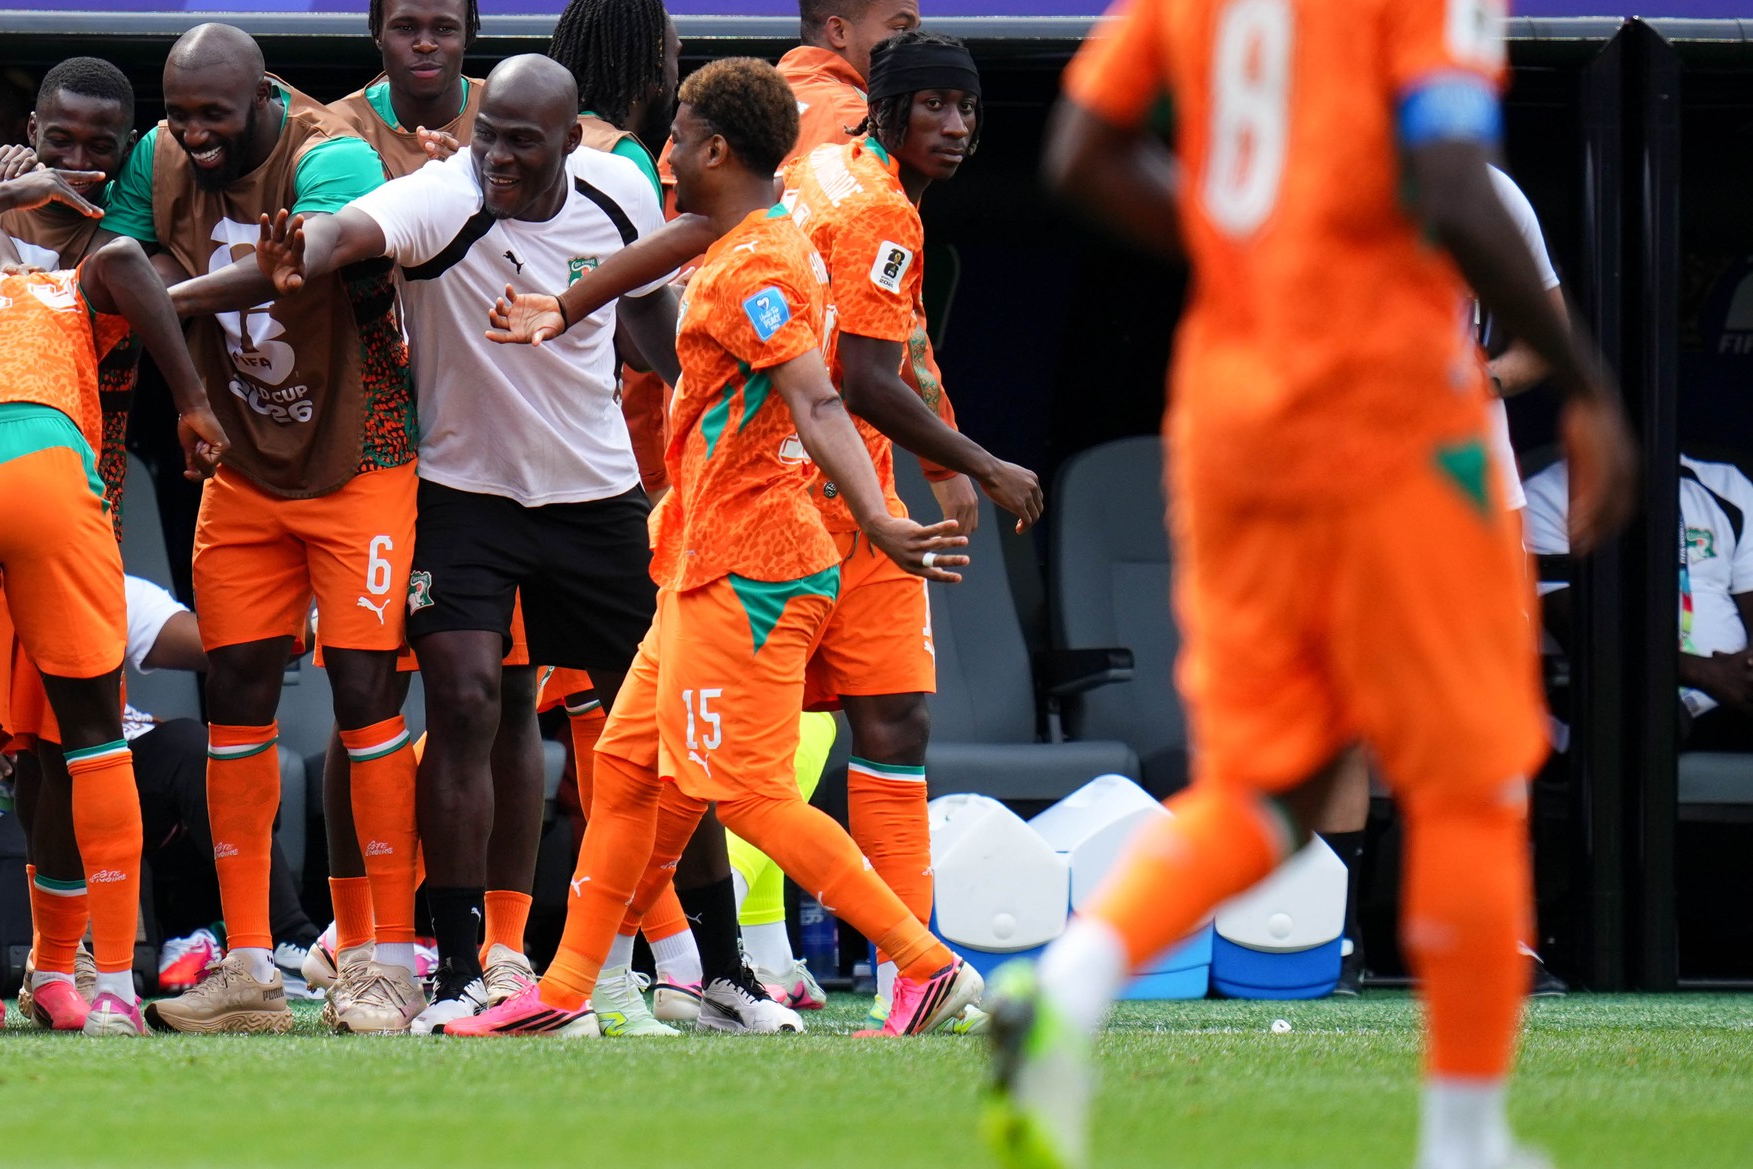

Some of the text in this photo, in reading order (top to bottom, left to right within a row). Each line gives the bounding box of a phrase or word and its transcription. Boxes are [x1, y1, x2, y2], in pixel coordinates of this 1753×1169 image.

[271, 383, 309, 404] CUP
[366, 535, 394, 595] 6
[682, 687, 724, 750] 15
[262, 986, 285, 1002] PUMA
